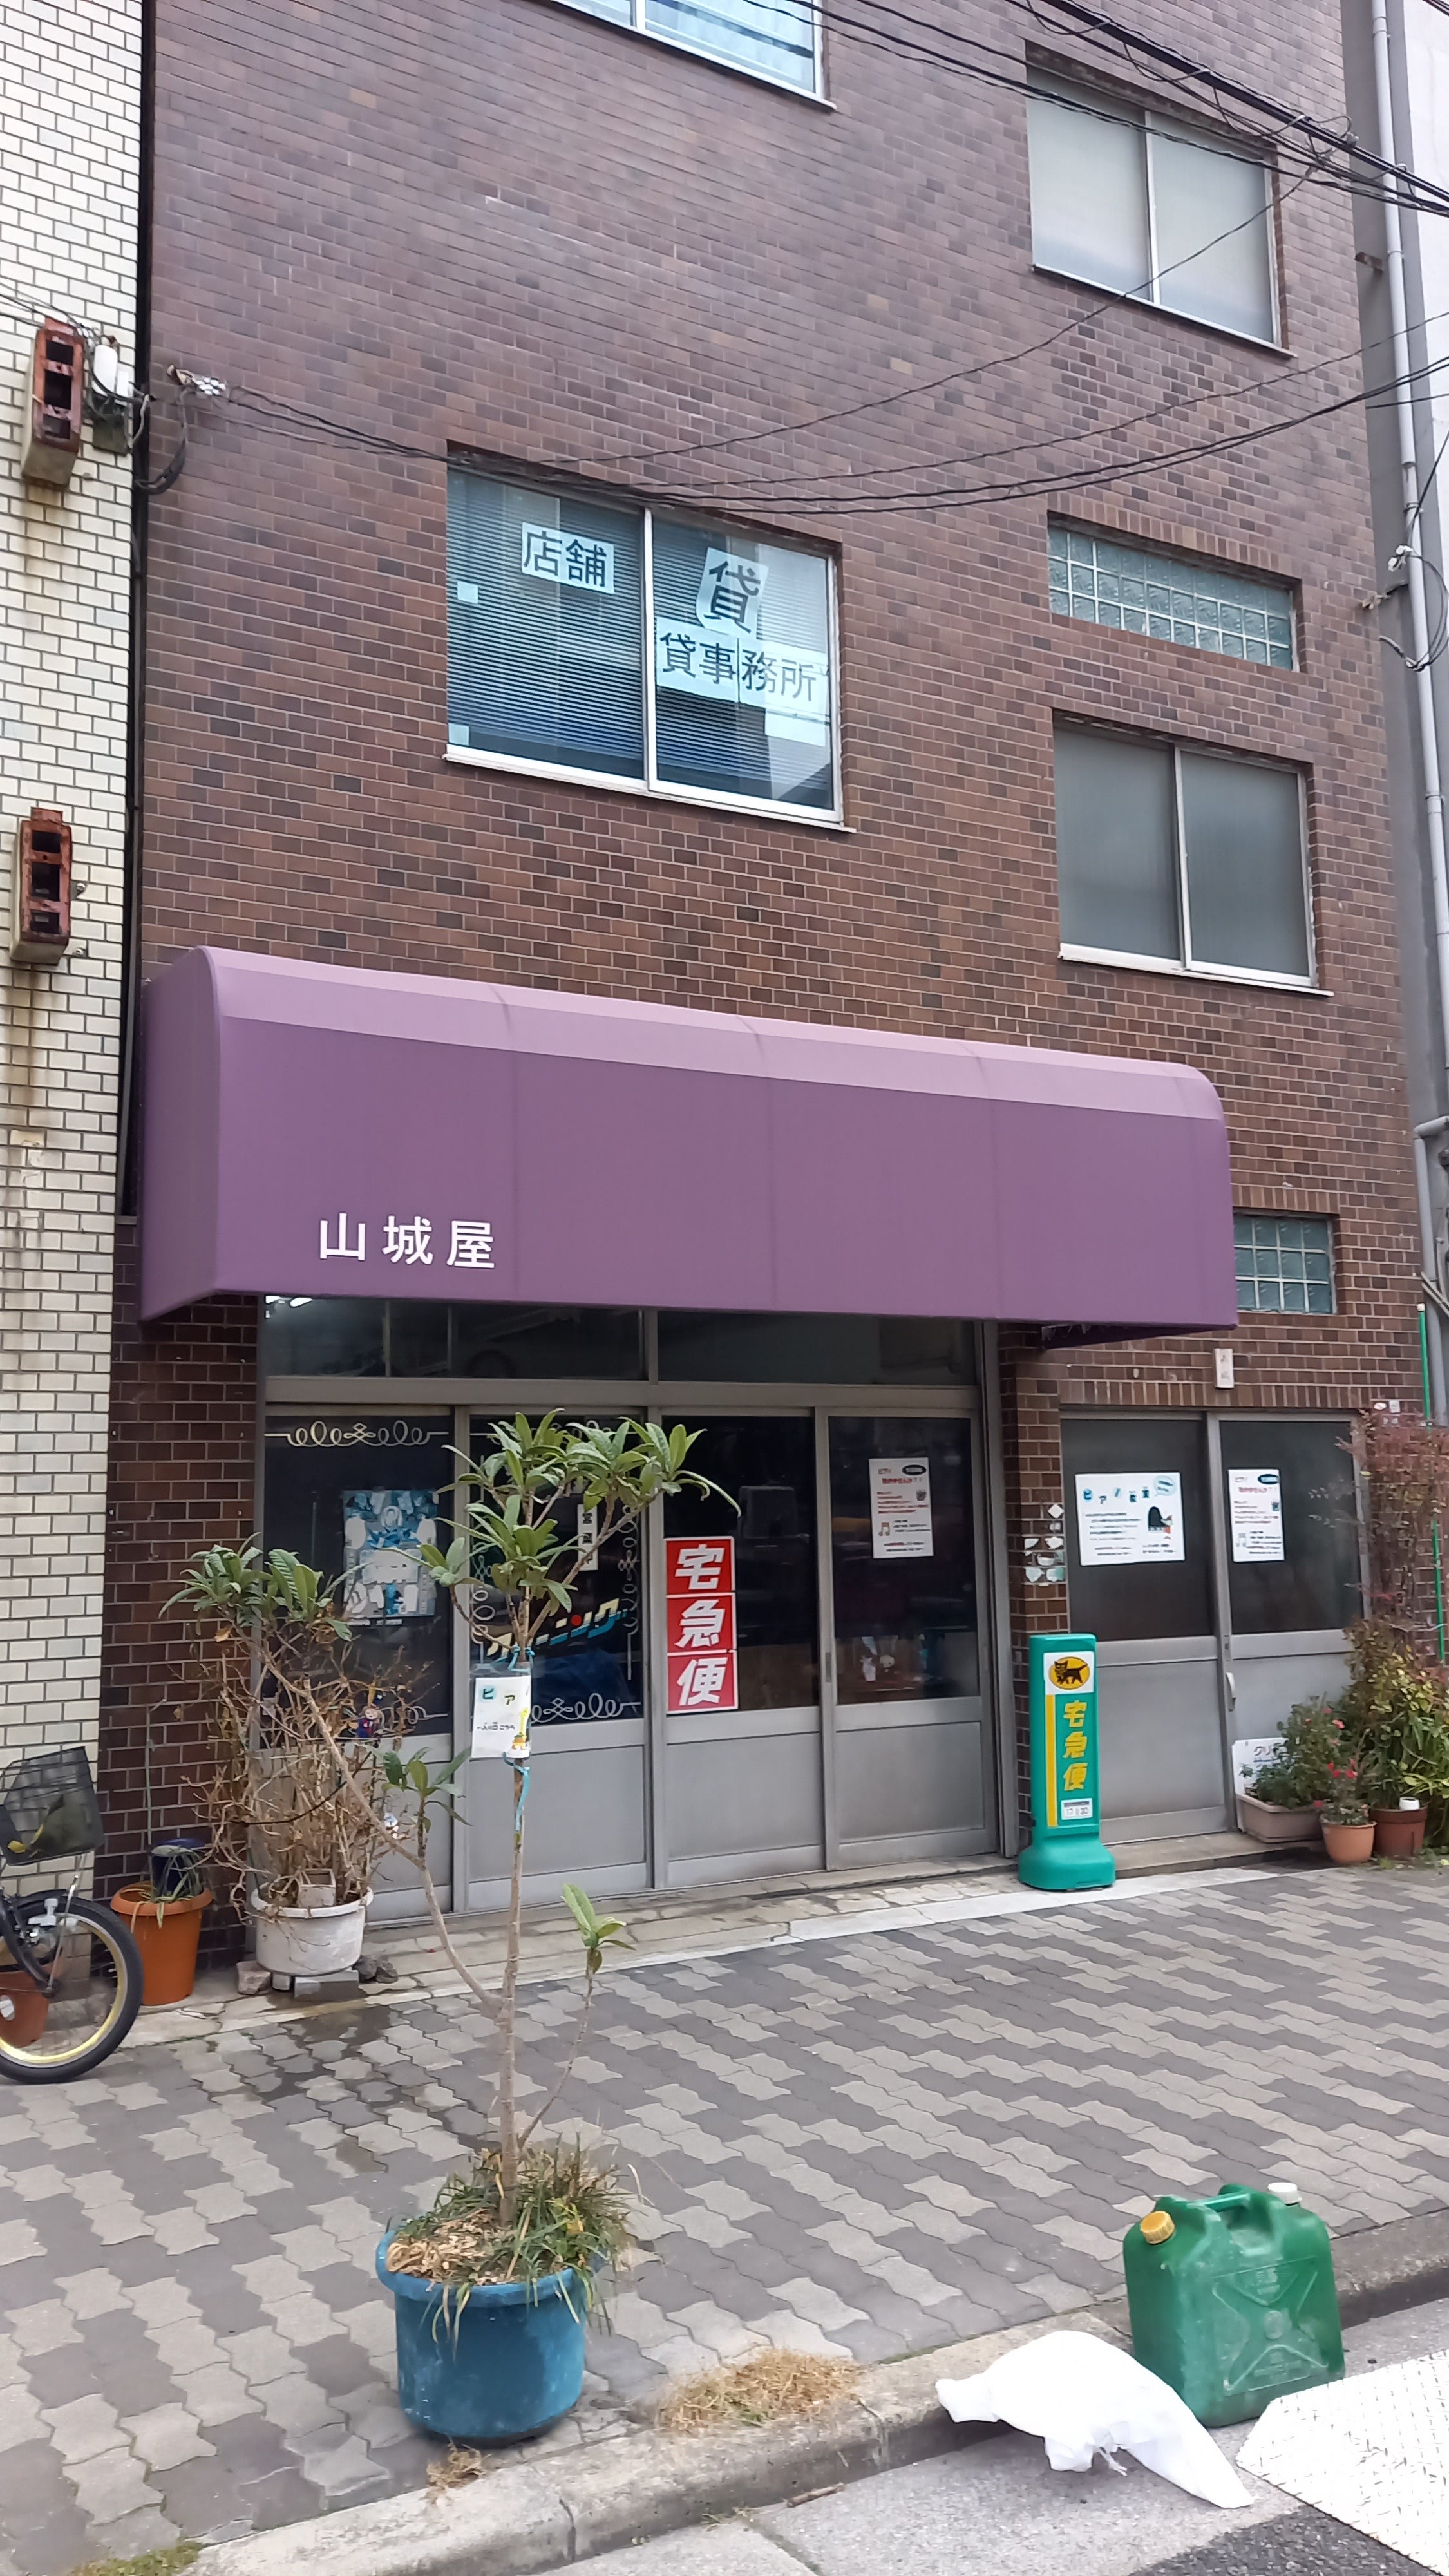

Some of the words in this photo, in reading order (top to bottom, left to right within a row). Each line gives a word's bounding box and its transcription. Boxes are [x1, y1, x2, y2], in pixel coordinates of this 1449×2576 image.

[522, 530, 607, 587] 店舗
[705, 560, 760, 634] 貸
[660, 633, 817, 702] 貸事務所
[319, 1212, 495, 1269] 山城屋
[675, 1544, 728, 1706] 宅急便
[1063, 1700, 1088, 1791] 宅急便
